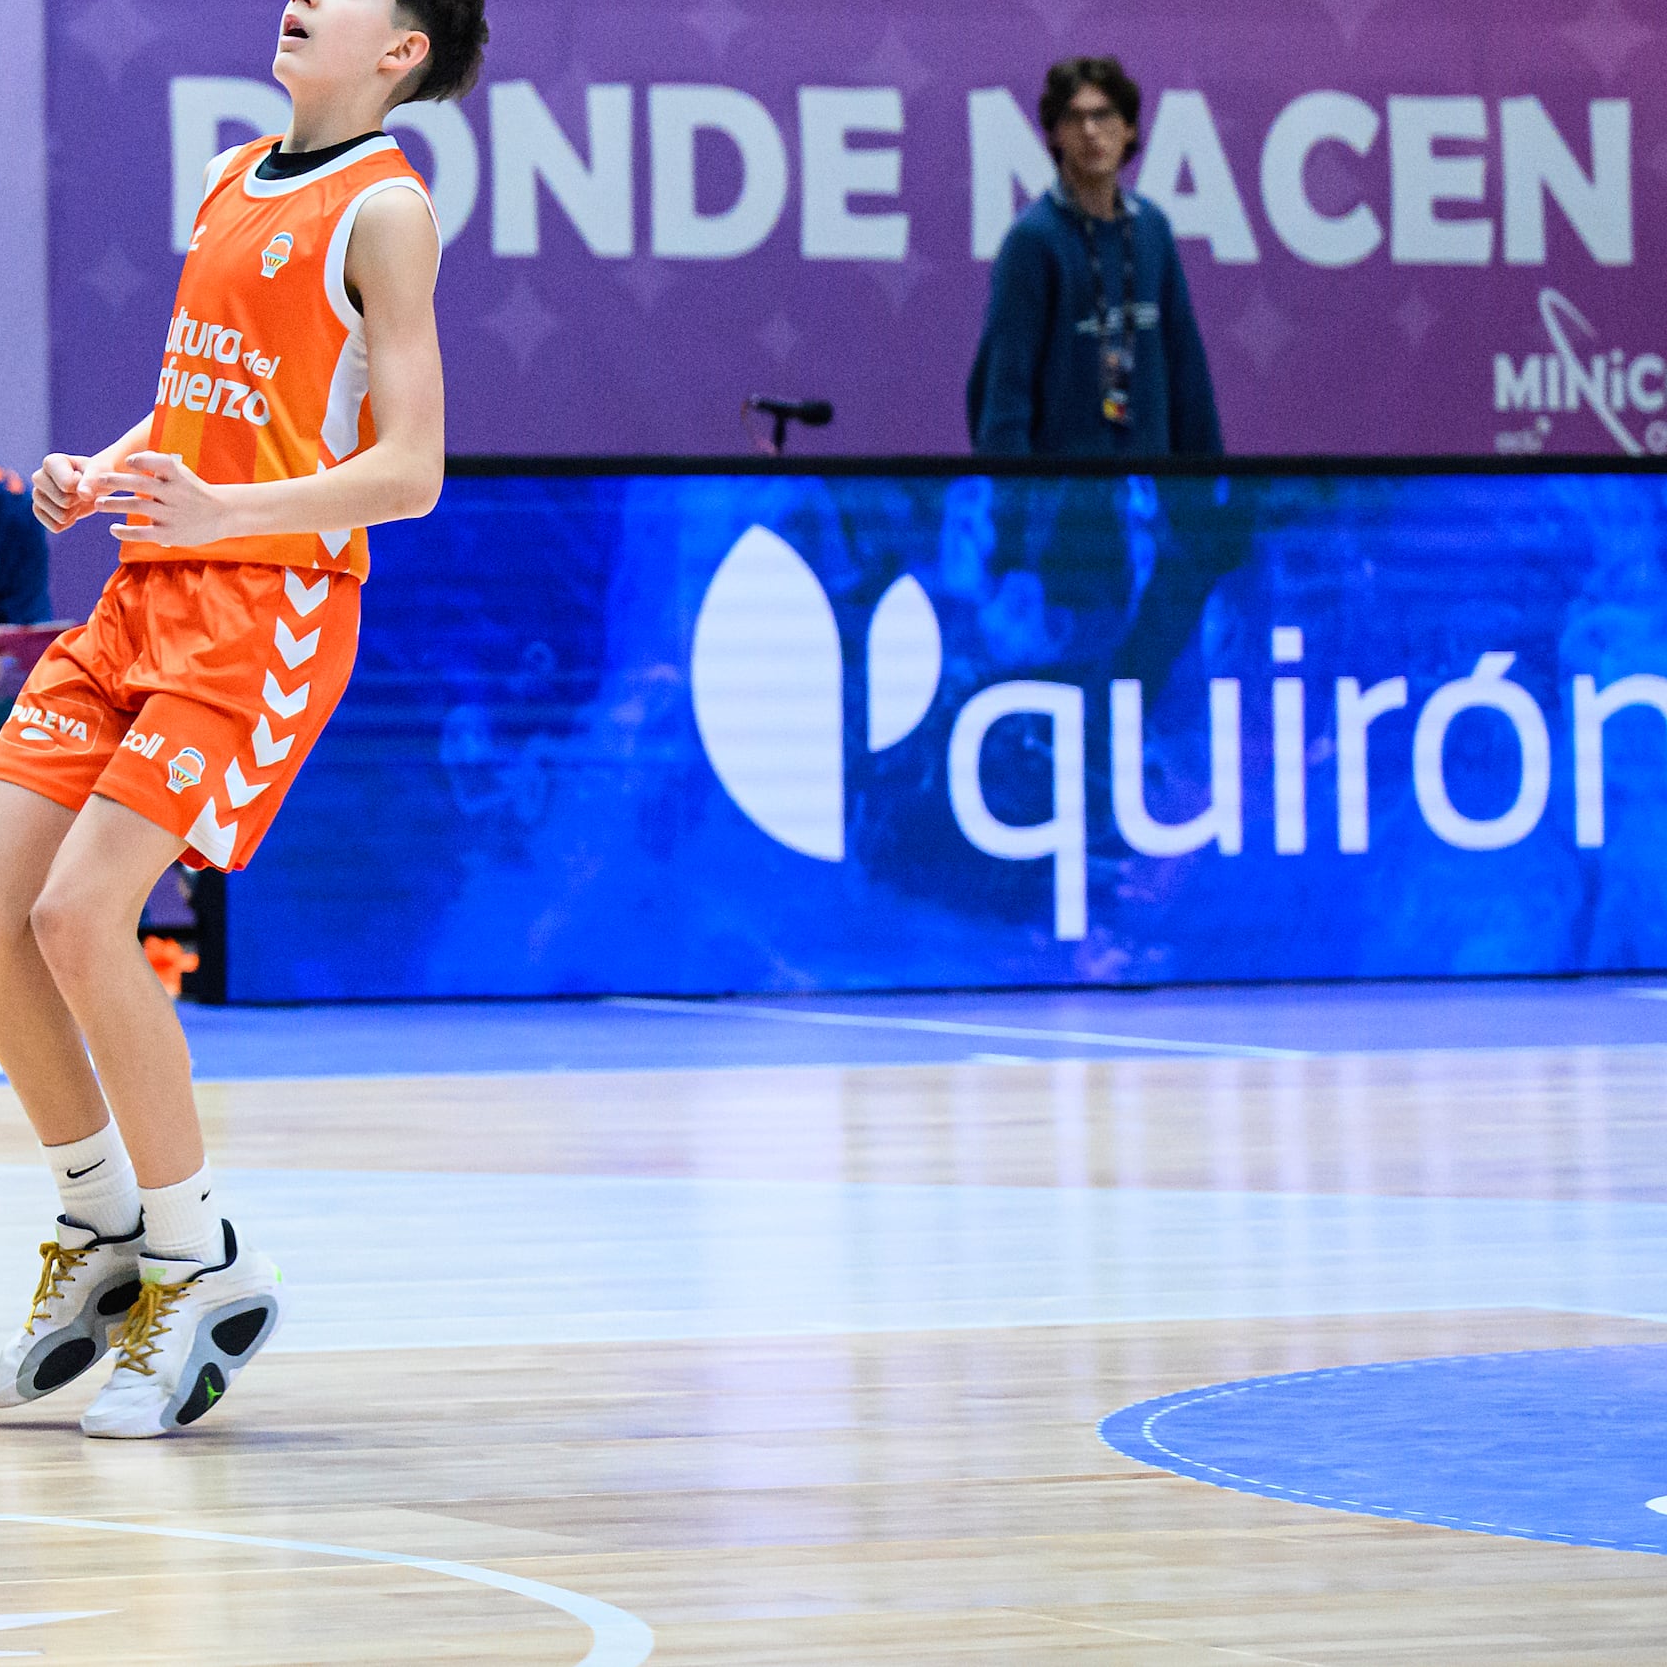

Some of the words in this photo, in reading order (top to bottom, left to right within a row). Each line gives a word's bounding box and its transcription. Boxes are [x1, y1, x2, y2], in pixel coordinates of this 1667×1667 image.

[967, 86, 1635, 268] NACEN
[242, 348, 282, 381] del
[6, 704, 88, 742] PULEVA
[947, 626, 1667, 940] quirón
